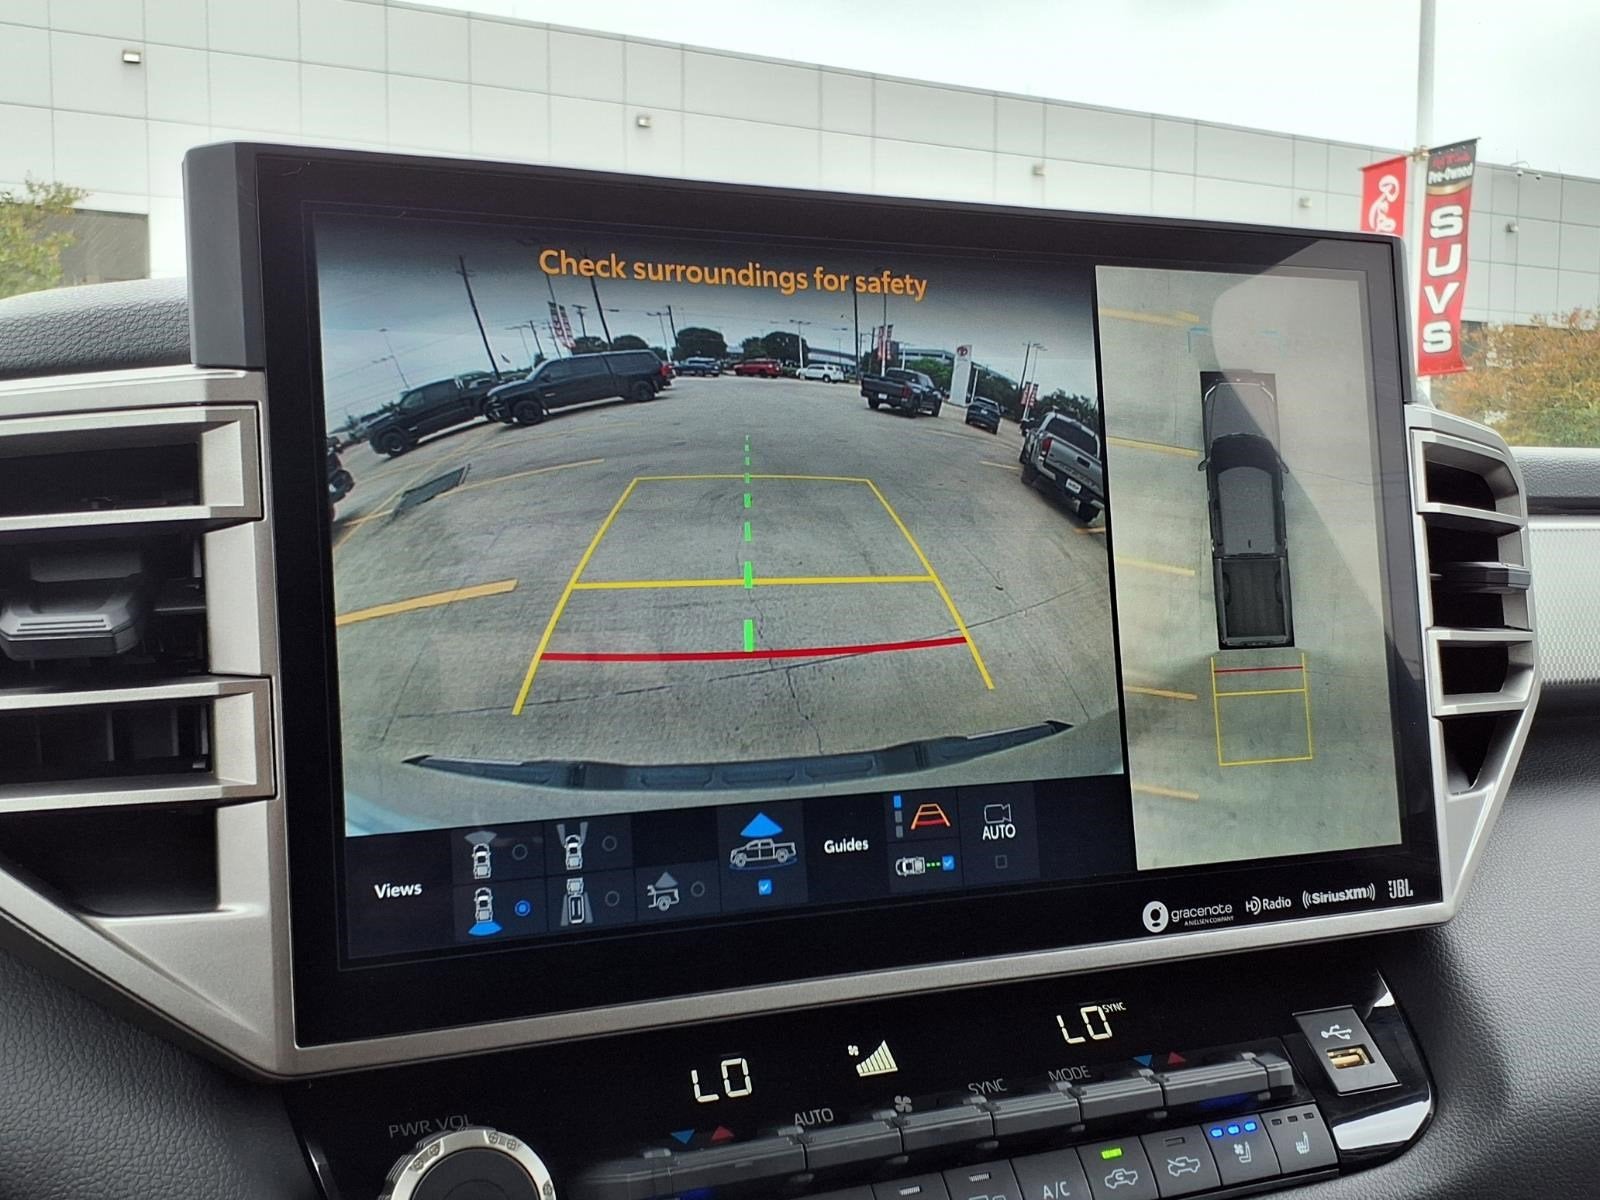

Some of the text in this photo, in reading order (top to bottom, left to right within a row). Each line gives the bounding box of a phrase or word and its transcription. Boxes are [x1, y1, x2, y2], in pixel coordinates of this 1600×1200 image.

[538, 249, 927, 302] Check surroundings for safety
[1422, 204, 1464, 354] SUVS
[982, 823, 1016, 841] AUTO
[824, 837, 869, 854] Guides
[374, 883, 423, 899] Views
[1388, 878, 1414, 899] JBL
[1262, 896, 1292, 910] Radio
[1171, 904, 1233, 923] gracenote
[1102, 1001, 1127, 1013] SYNC
[1048, 1065, 1091, 1081] MODE
[968, 1078, 1007, 1095] SYNC
[388, 1114, 473, 1138] PWR VOL
[794, 1107, 834, 1127] AUTO
[1043, 1181, 1070, 1200] A/C
